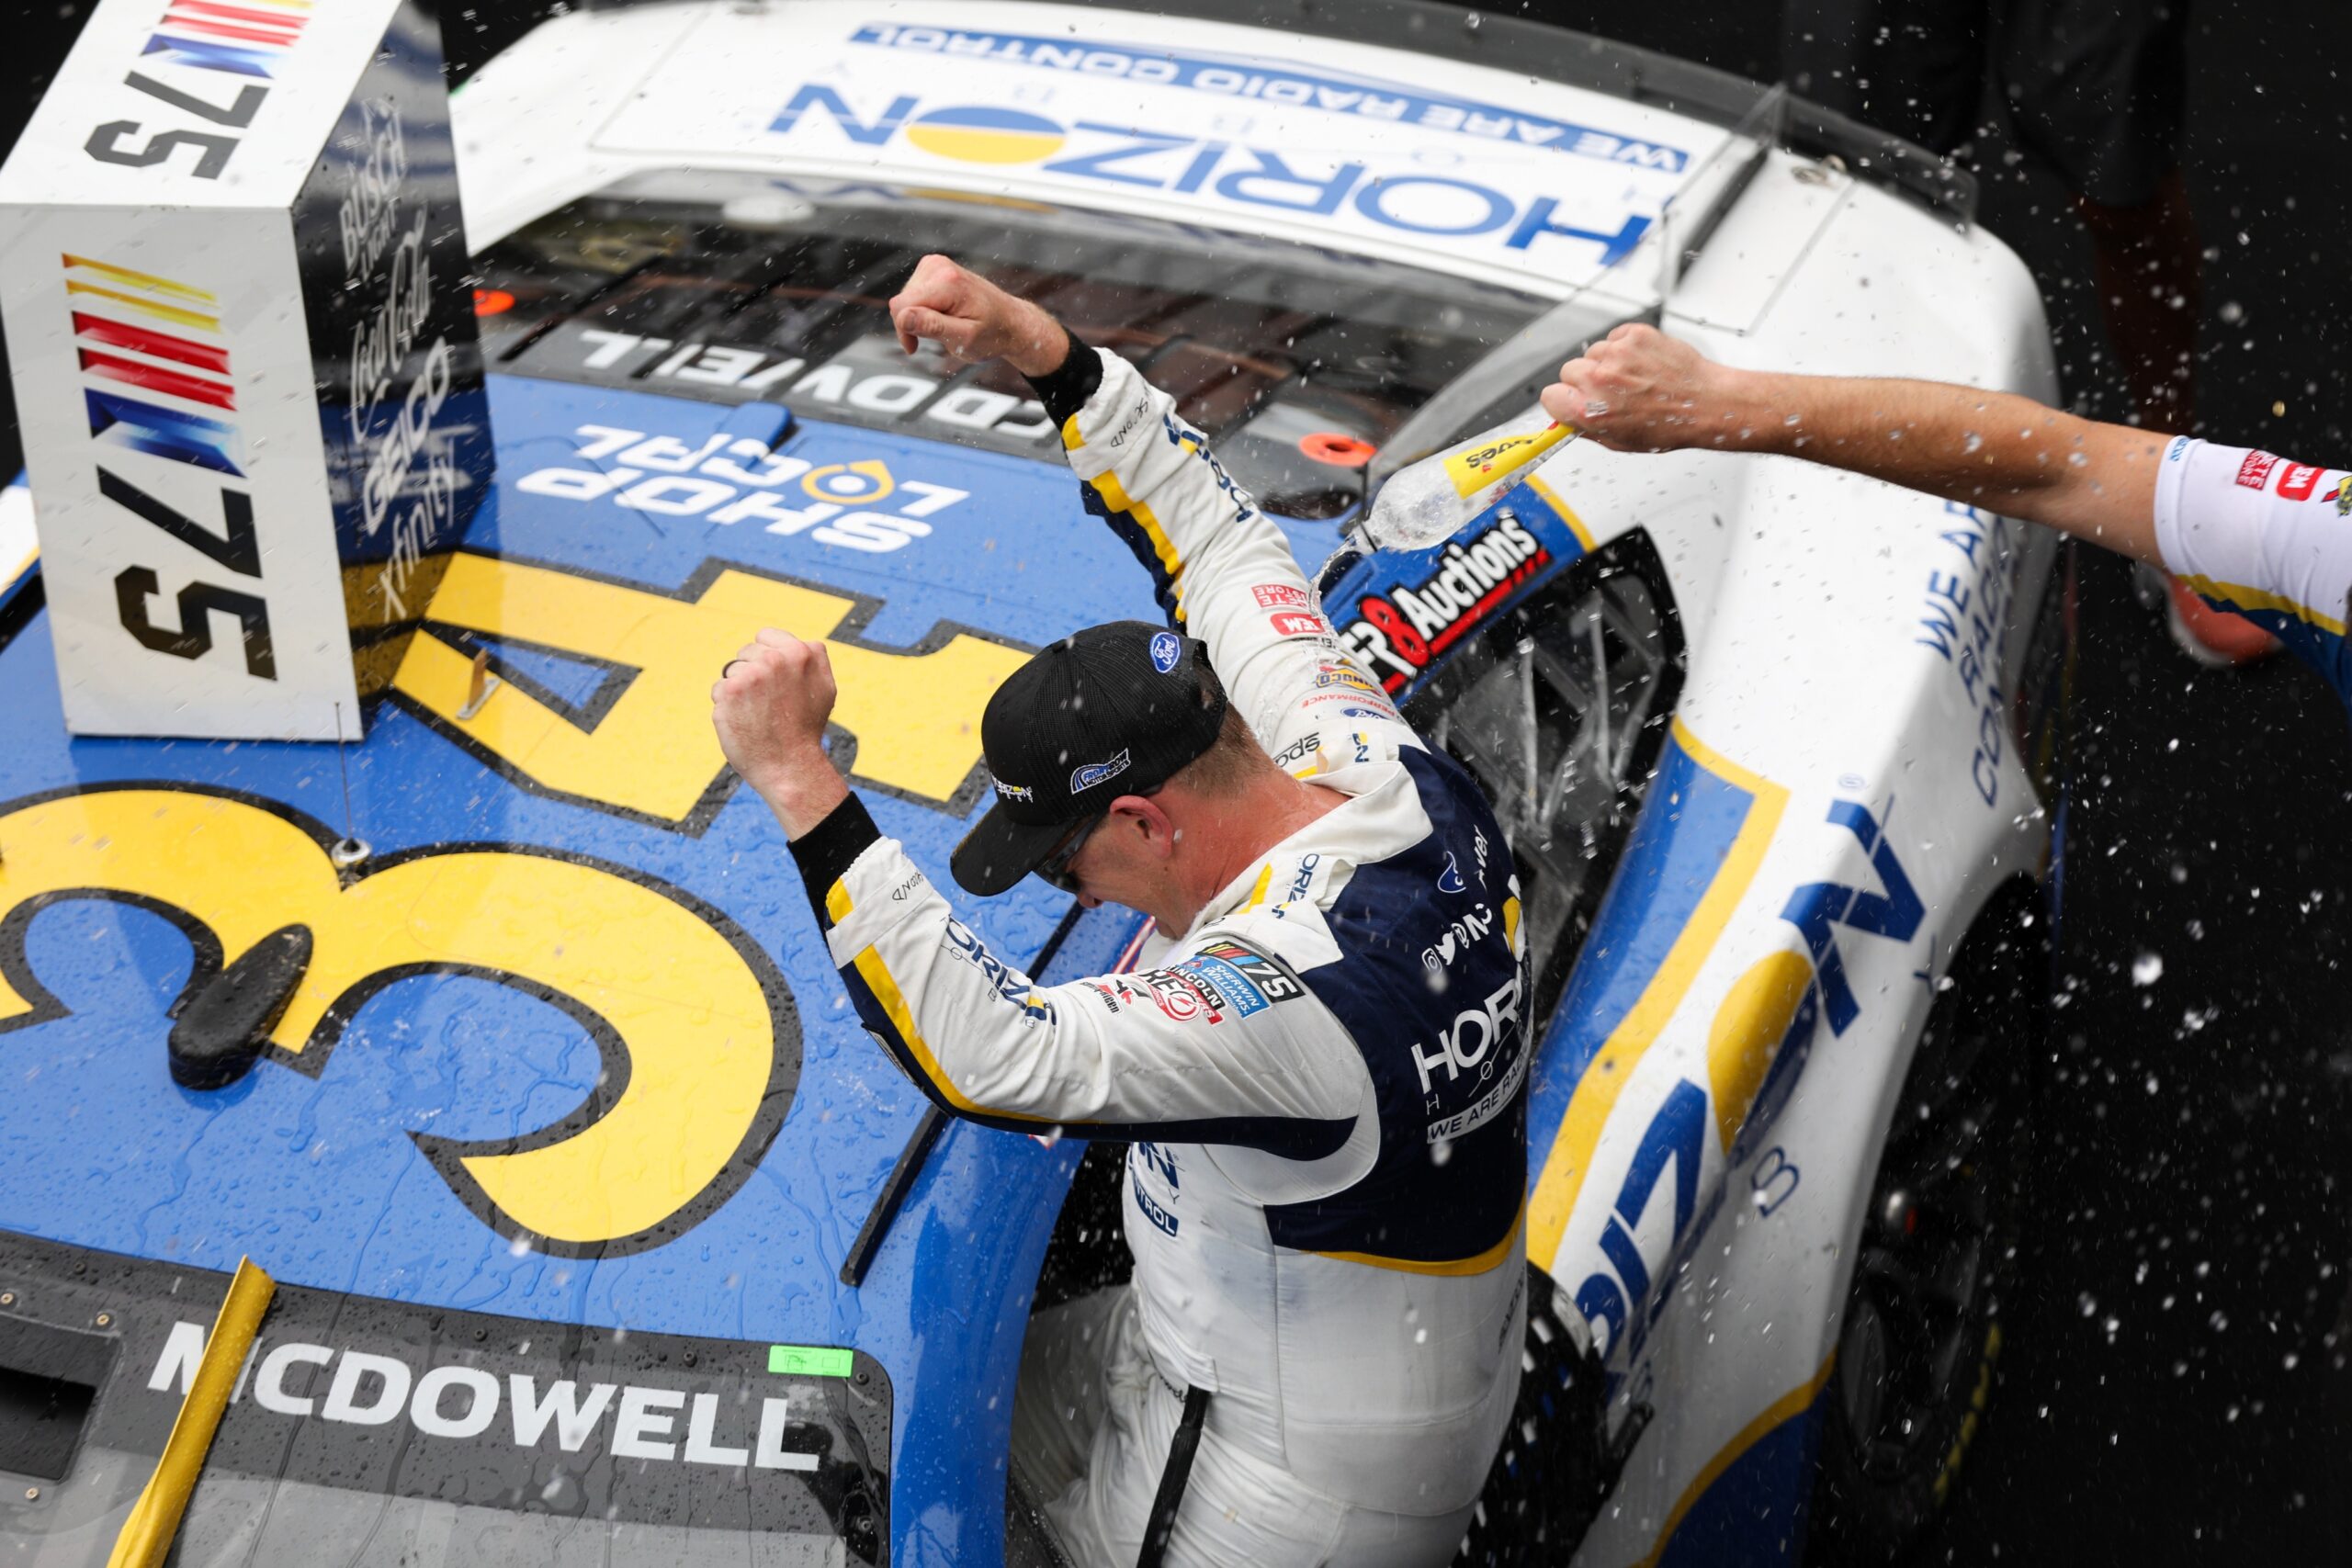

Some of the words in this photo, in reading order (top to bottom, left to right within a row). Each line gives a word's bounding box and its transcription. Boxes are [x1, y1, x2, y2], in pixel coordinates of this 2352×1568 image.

[866, 25, 1179, 84] CONTROL
[85, 70, 270, 180] 75
[1193, 68, 1410, 122] RADIO
[1419, 103, 1565, 144] ARE
[766, 85, 1652, 268] HORIZON
[1574, 131, 1681, 172] WE
[342, 110, 406, 274] BUSCH
[581, 331, 1057, 439] CDOWELL
[363, 338, 447, 536] GEICO
[381, 436, 457, 625] xfinity
[516, 467, 933, 553] SHOP
[1941, 502, 1985, 571] AR
[96, 464, 278, 682] 75
[1916, 570, 1969, 661] WE
[1154, 637, 1176, 665] Ford
[1317, 670, 1374, 690] UNOCO
[1200, 967, 1248, 1014] WILLIAMS
[1212, 964, 1260, 1007] SHERWIN
[1241, 962, 1298, 998] 75
[1430, 1116, 1463, 1140] WE
[1467, 1089, 1500, 1125] ARE
